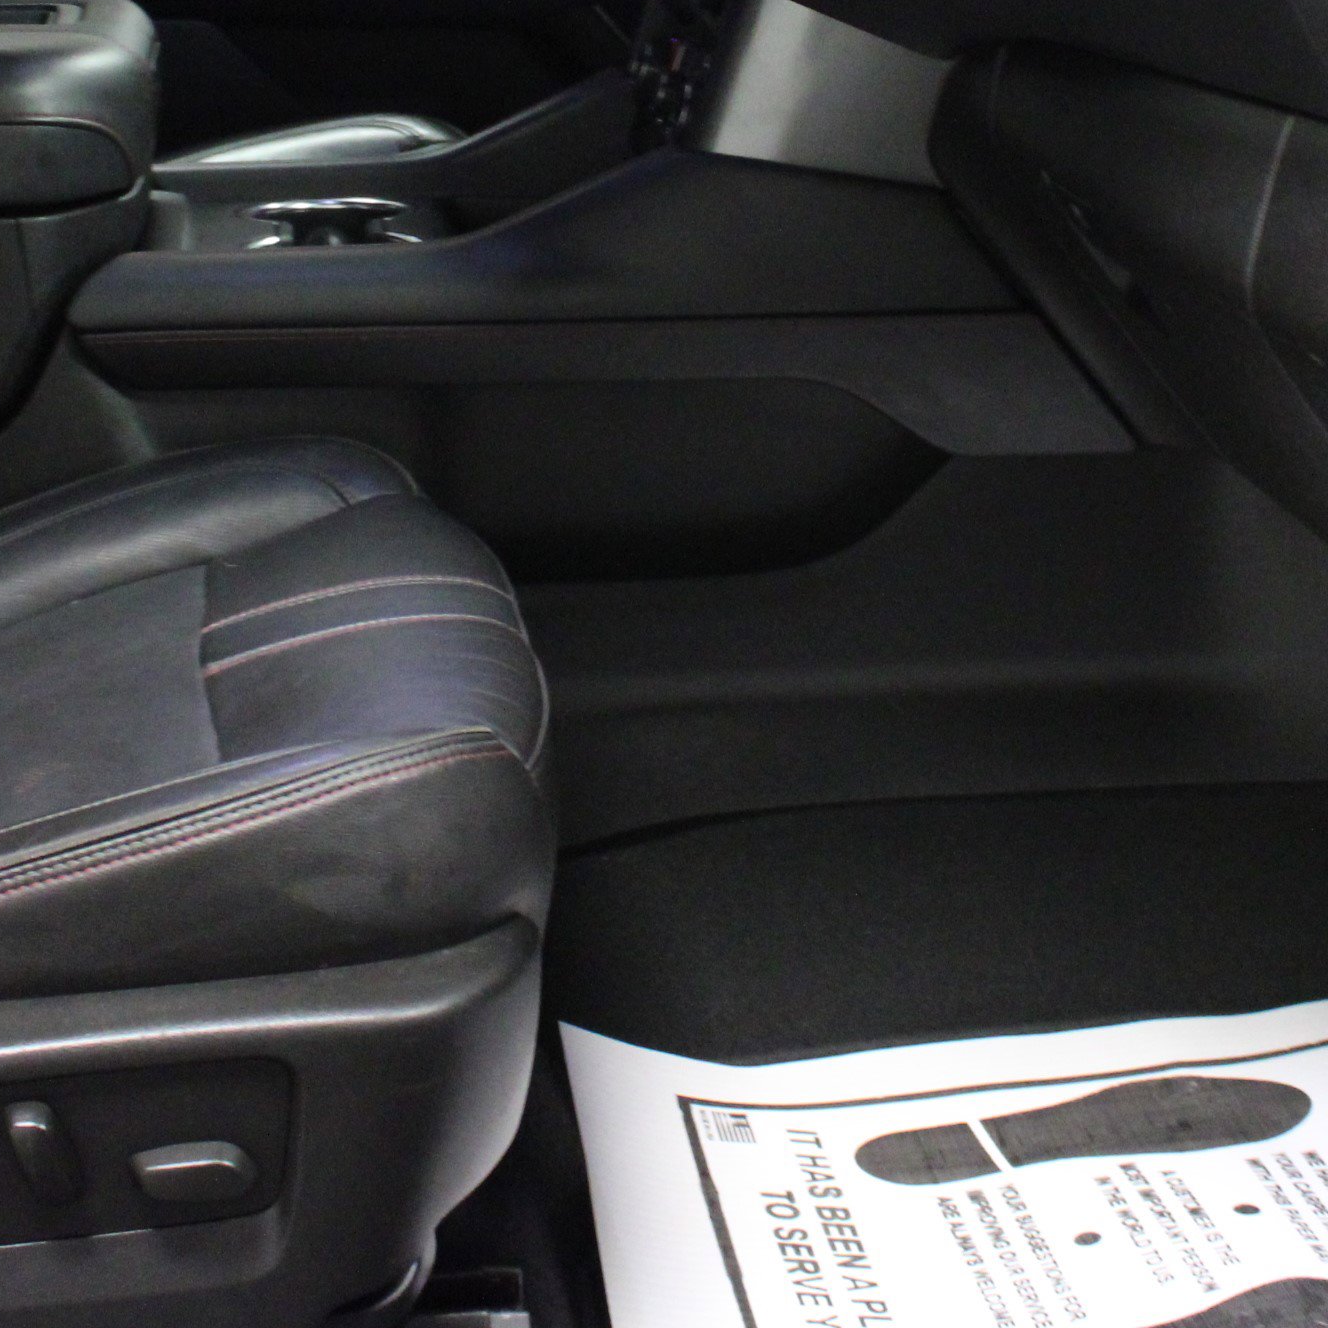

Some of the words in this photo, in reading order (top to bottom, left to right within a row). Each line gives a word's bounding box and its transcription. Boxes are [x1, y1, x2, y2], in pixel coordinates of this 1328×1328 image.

[786, 1129, 823, 1149] IT
[795, 1154, 843, 1199] HAS
[1273, 1152, 1303, 1179] YOUR
[759, 1190, 801, 1220] TO
[937, 1196, 961, 1219] ARE
[815, 1205, 872, 1270] BEEN
[1282, 1208, 1320, 1241] PAPER
[773, 1227, 834, 1307] SERVE
[999, 1184, 1027, 1212] YOUR
[1061, 1295, 1087, 1322] FOR
[999, 1251, 1025, 1276] OUR
[842, 1275, 879, 1291] A
